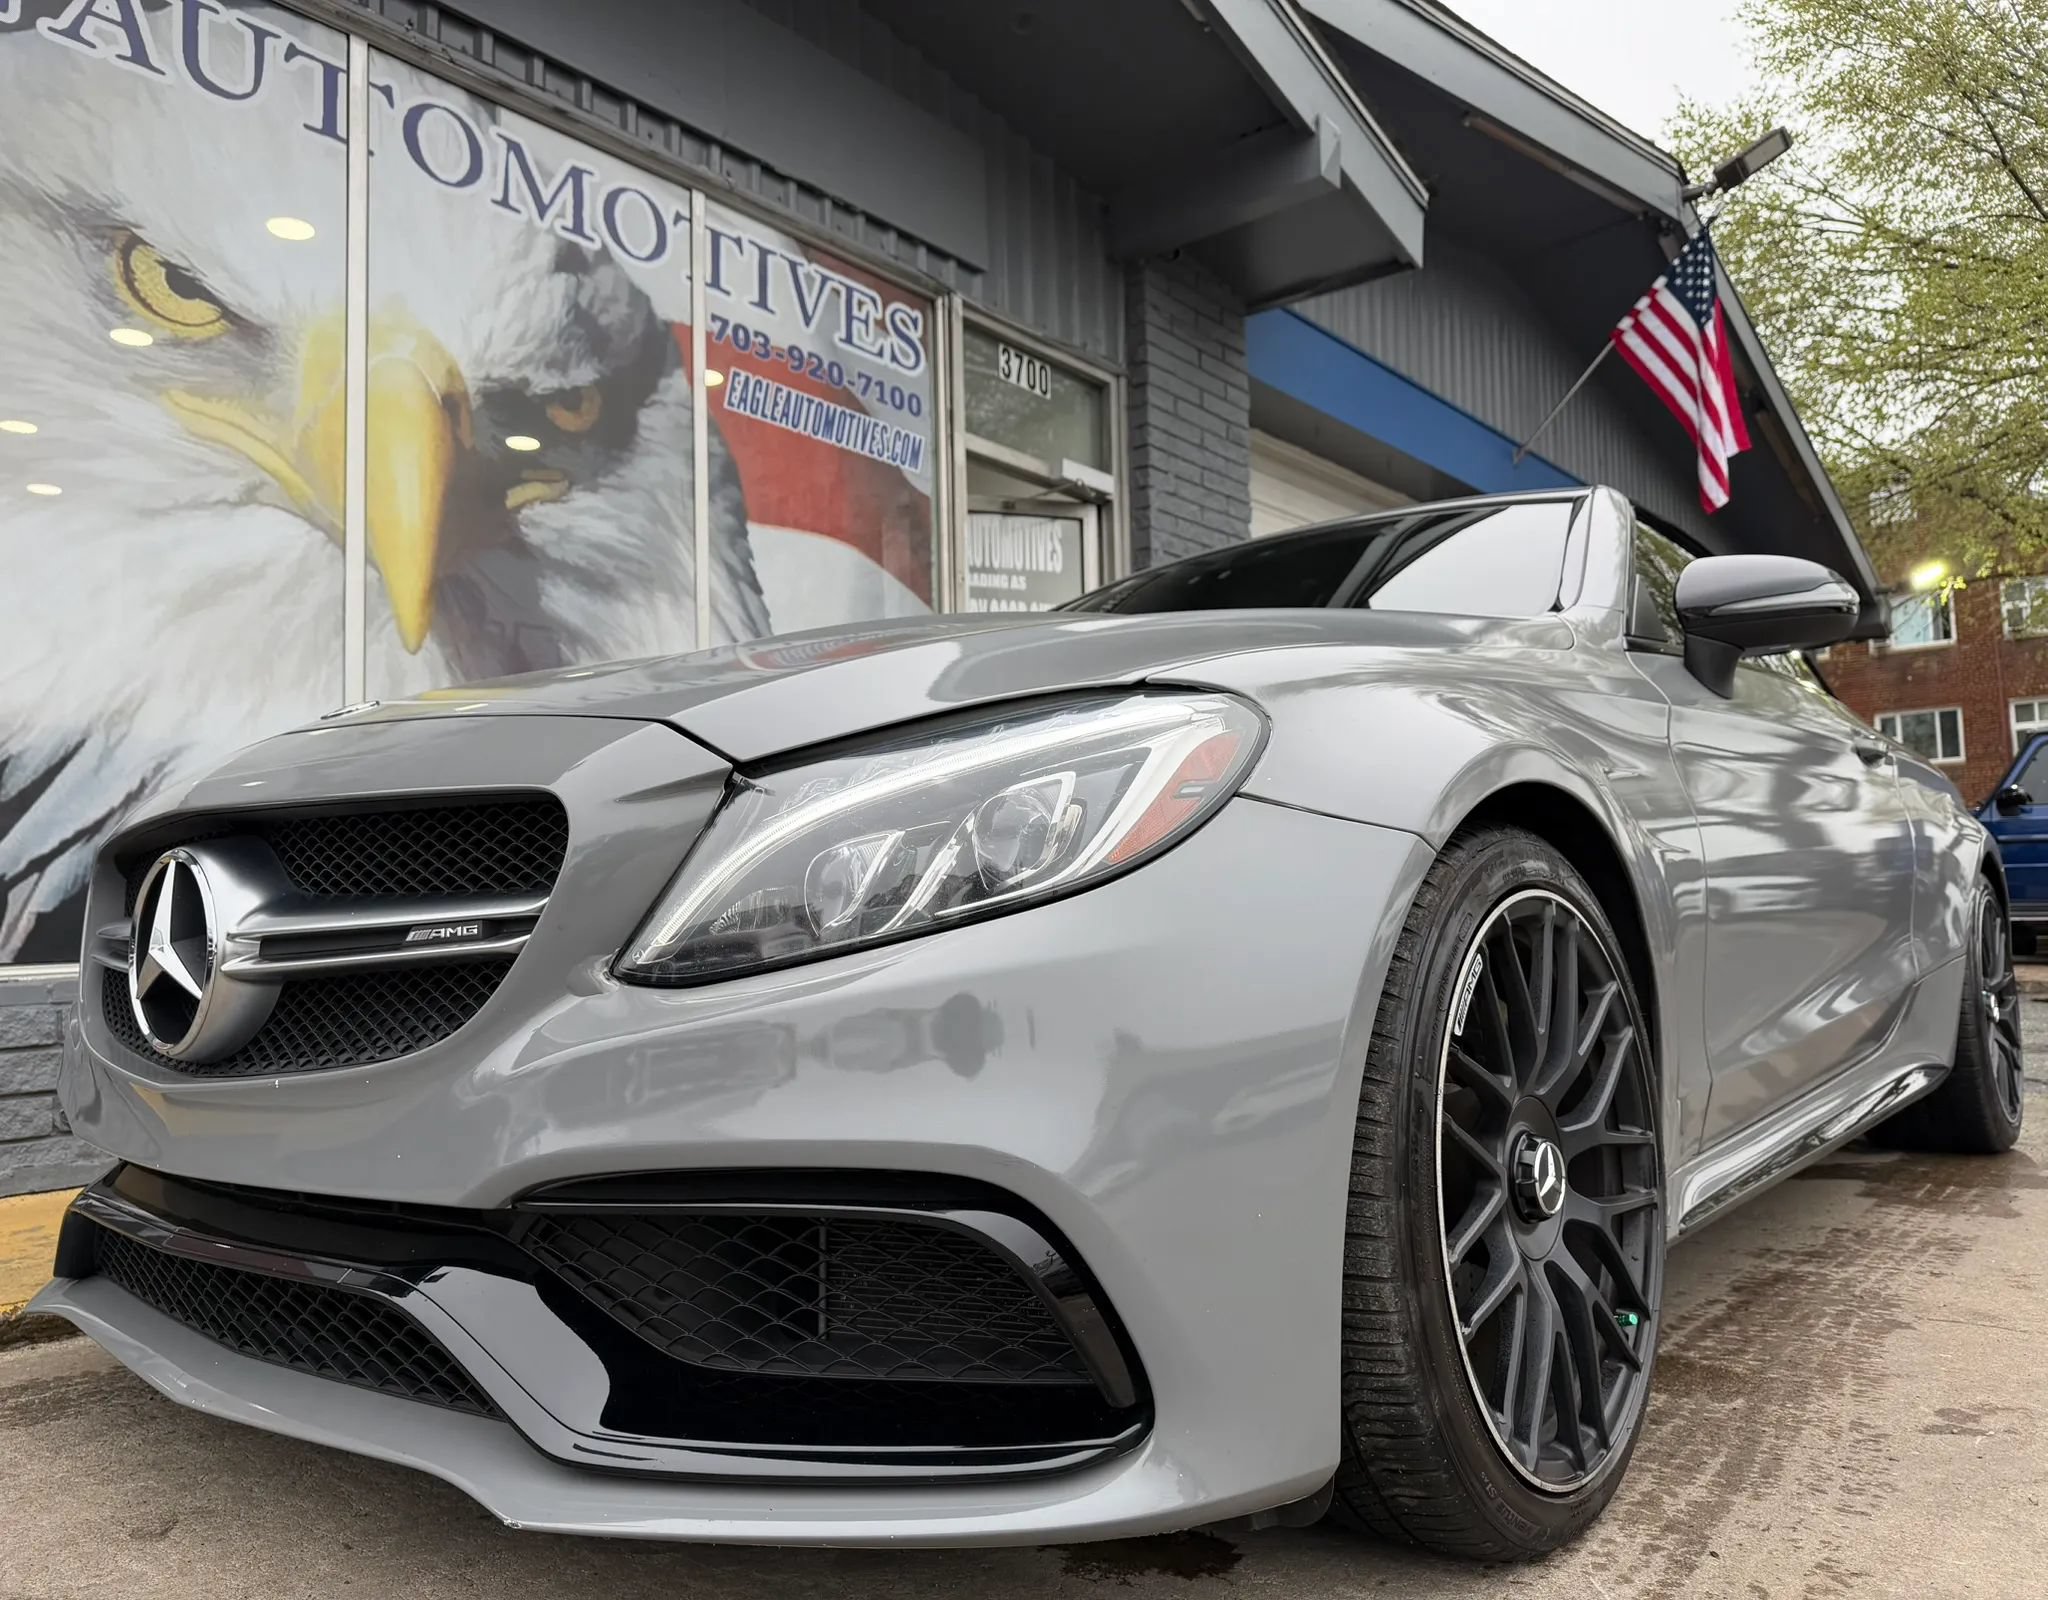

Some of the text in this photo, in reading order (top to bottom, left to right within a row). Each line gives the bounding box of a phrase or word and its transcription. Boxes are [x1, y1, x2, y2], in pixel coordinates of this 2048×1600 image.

[47, 0, 922, 371] AUTOMOTIVES
[710, 312, 922, 417] 703-920-7100
[1002, 347, 1047, 395] 3700
[726, 370, 923, 470] EAGLEAUTOMOTIVES.COM
[1010, 575, 1027, 590] AS
